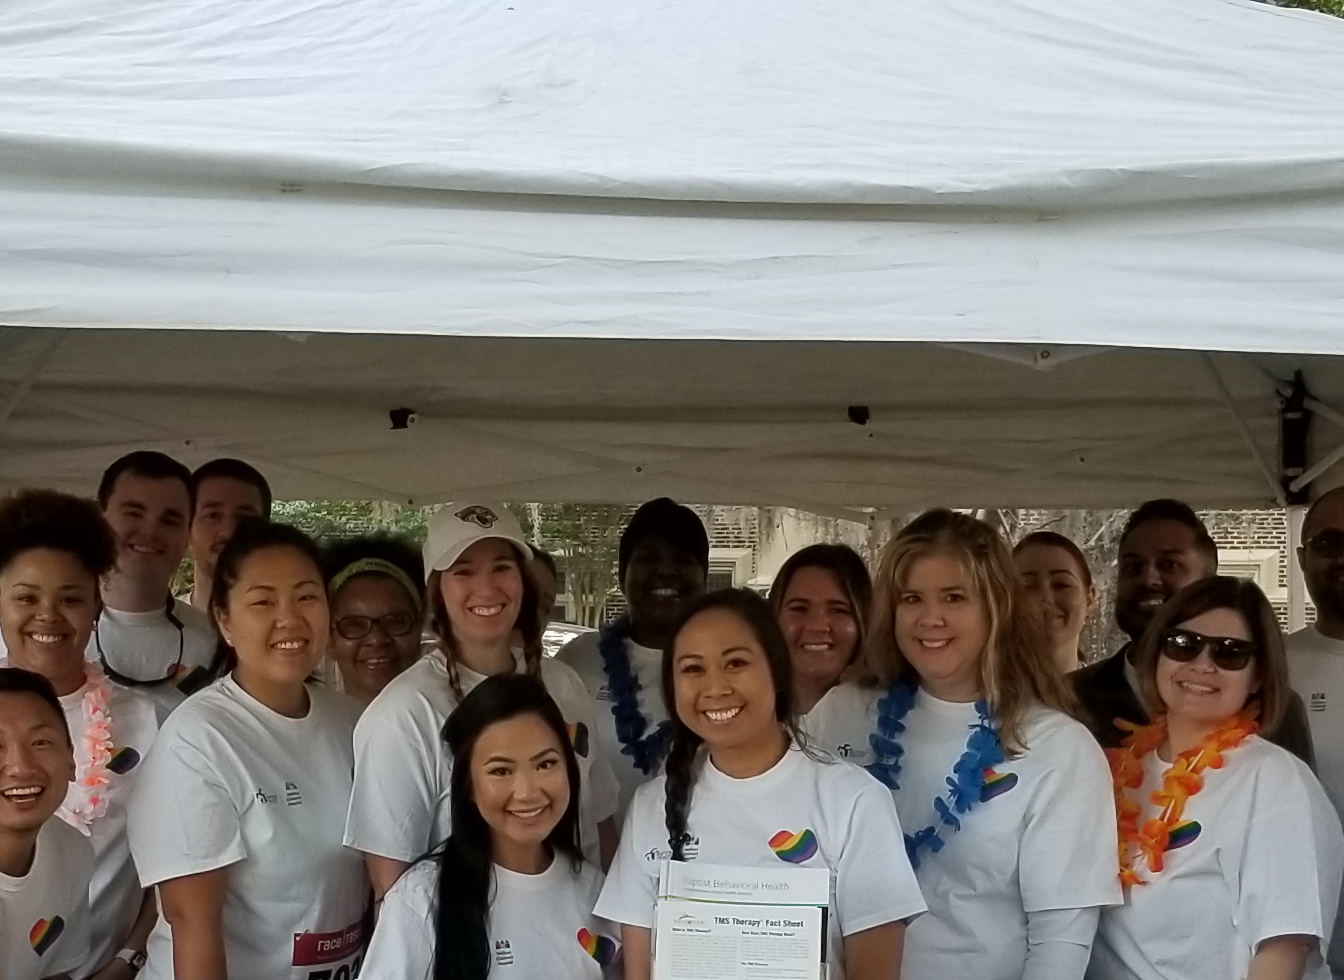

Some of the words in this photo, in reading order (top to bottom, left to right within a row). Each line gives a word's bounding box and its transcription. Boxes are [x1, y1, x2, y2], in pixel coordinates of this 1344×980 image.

[713, 879, 759, 890] Behavioral
[761, 881, 790, 891] Health
[713, 916, 730, 925] TMS
[732, 917, 761, 928] Therapy
[765, 919, 781, 927] Fact
[783, 920, 804, 928] Sheet
[317, 936, 342, 952] race
